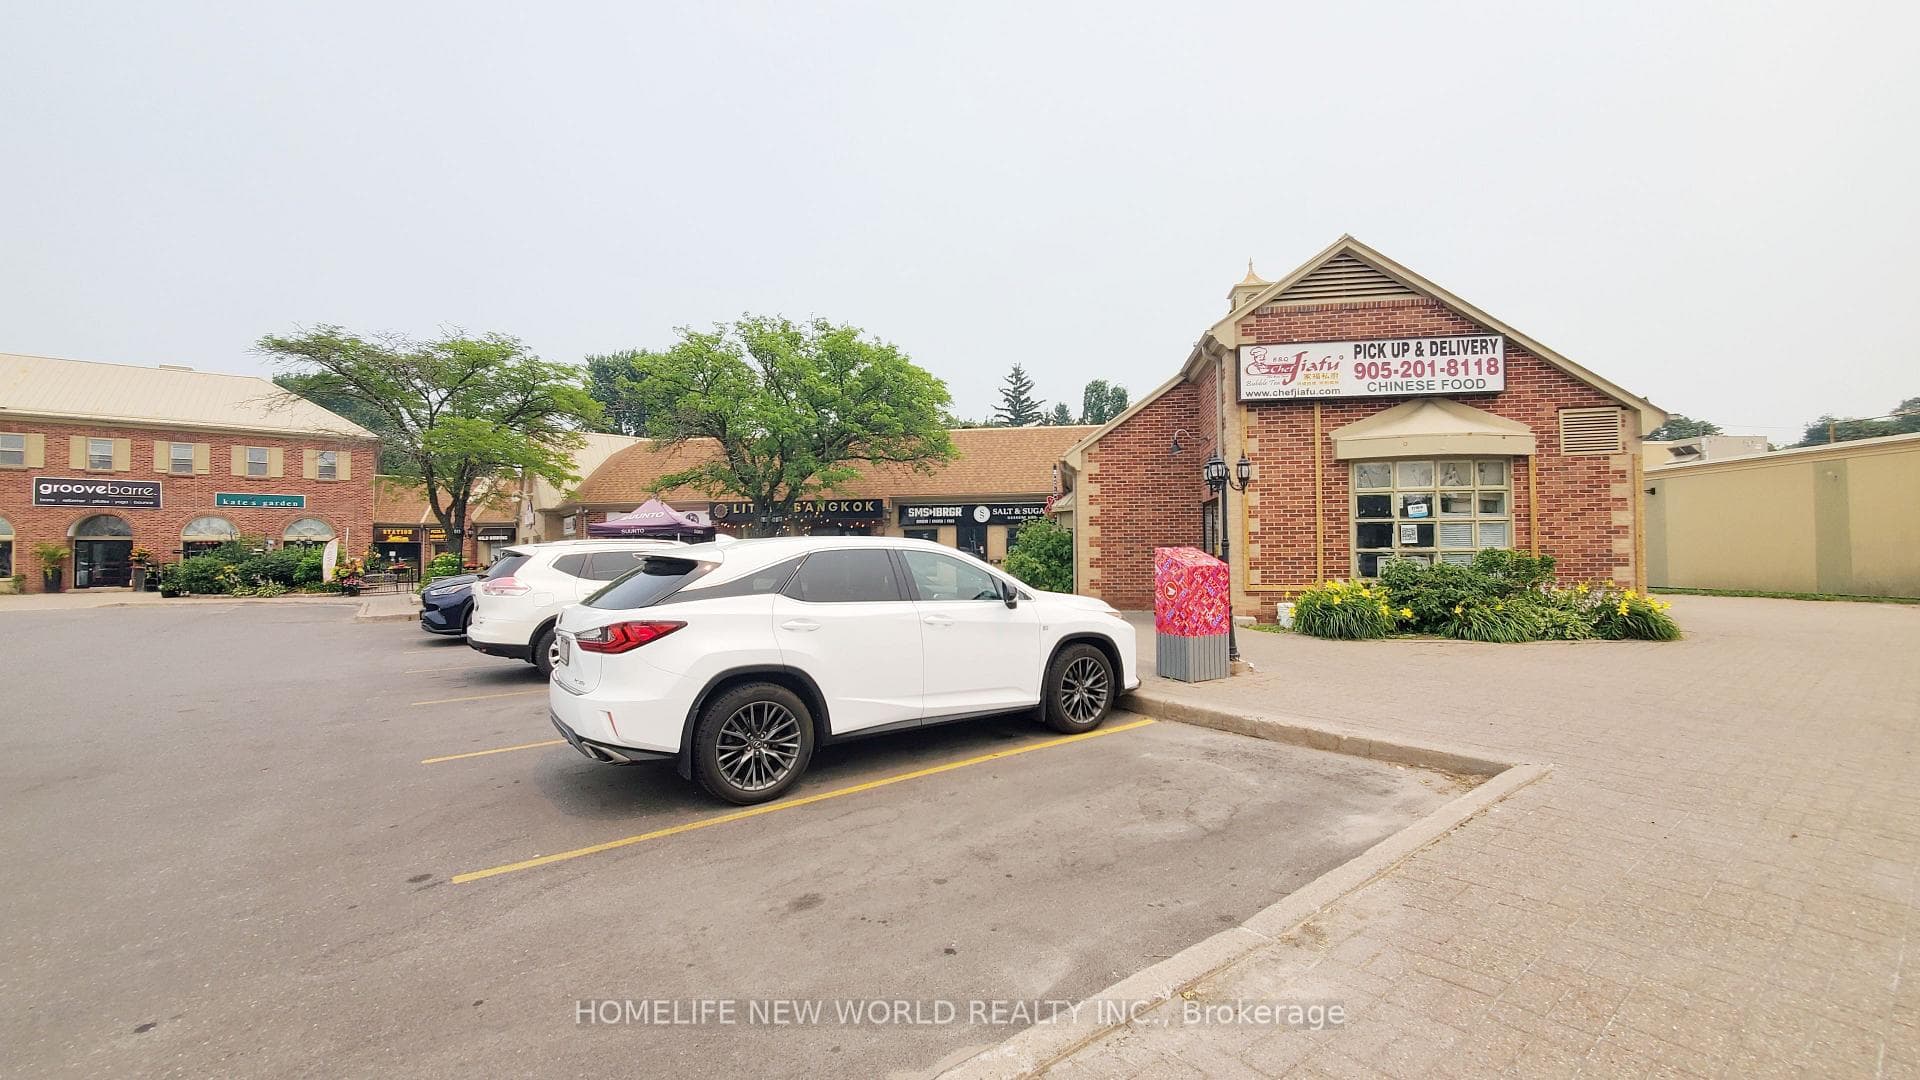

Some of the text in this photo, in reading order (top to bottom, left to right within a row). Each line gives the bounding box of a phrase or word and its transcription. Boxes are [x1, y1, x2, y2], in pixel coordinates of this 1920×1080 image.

[1354, 338, 1498, 359] PICK UP & DELIVERY
[1354, 357, 1499, 380] 905-201-8118
[1367, 378, 1486, 392] CHINESE FOOD
[1245, 388, 1341, 397] www.chefjiafu.com
[793, 501, 875, 513] BANGKOK
[992, 507, 1014, 515] SALT
[1014, 507, 1021, 515] &
[1022, 507, 1045, 515] SUGA
